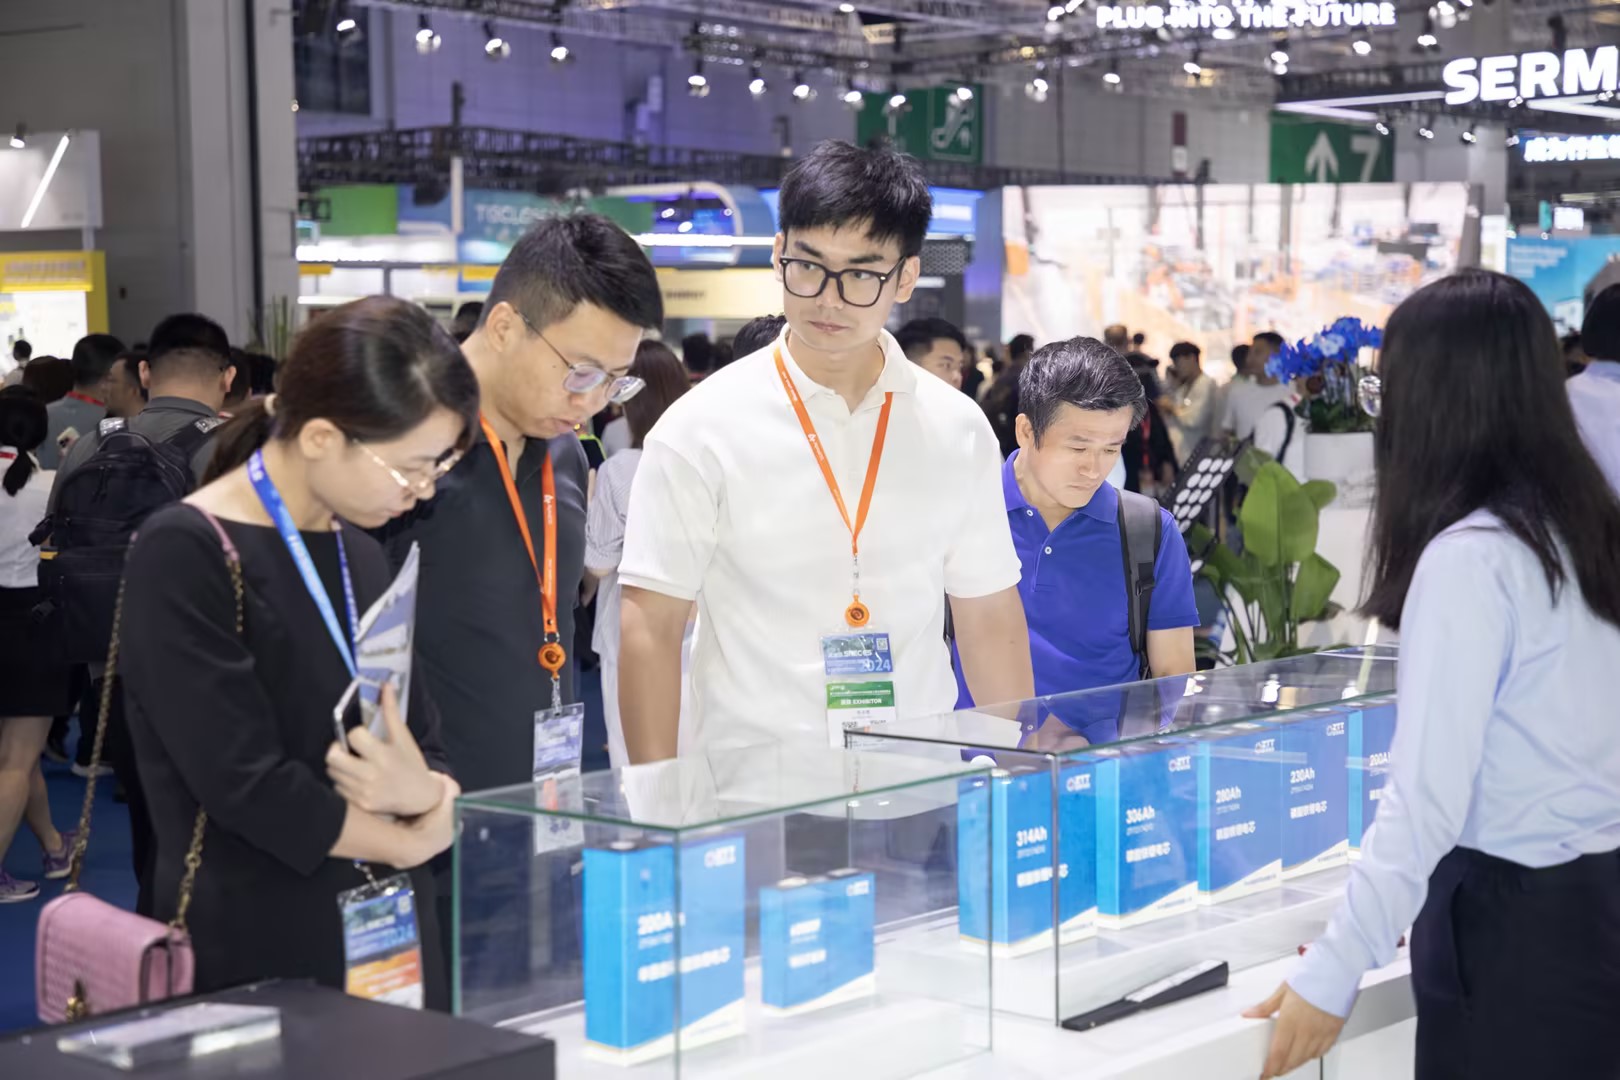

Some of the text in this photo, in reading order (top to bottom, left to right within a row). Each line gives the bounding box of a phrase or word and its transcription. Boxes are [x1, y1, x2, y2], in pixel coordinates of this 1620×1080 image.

[1096, 3, 1396, 28] PLUG INTO THE FUTURE
[1443, 46, 1620, 105] SERM
[1351, 135, 1380, 183] 7
[1290, 767, 1315, 784] 230Ah
[1126, 805, 1156, 825] 306Ah
[1016, 825, 1048, 847] 314Ah
